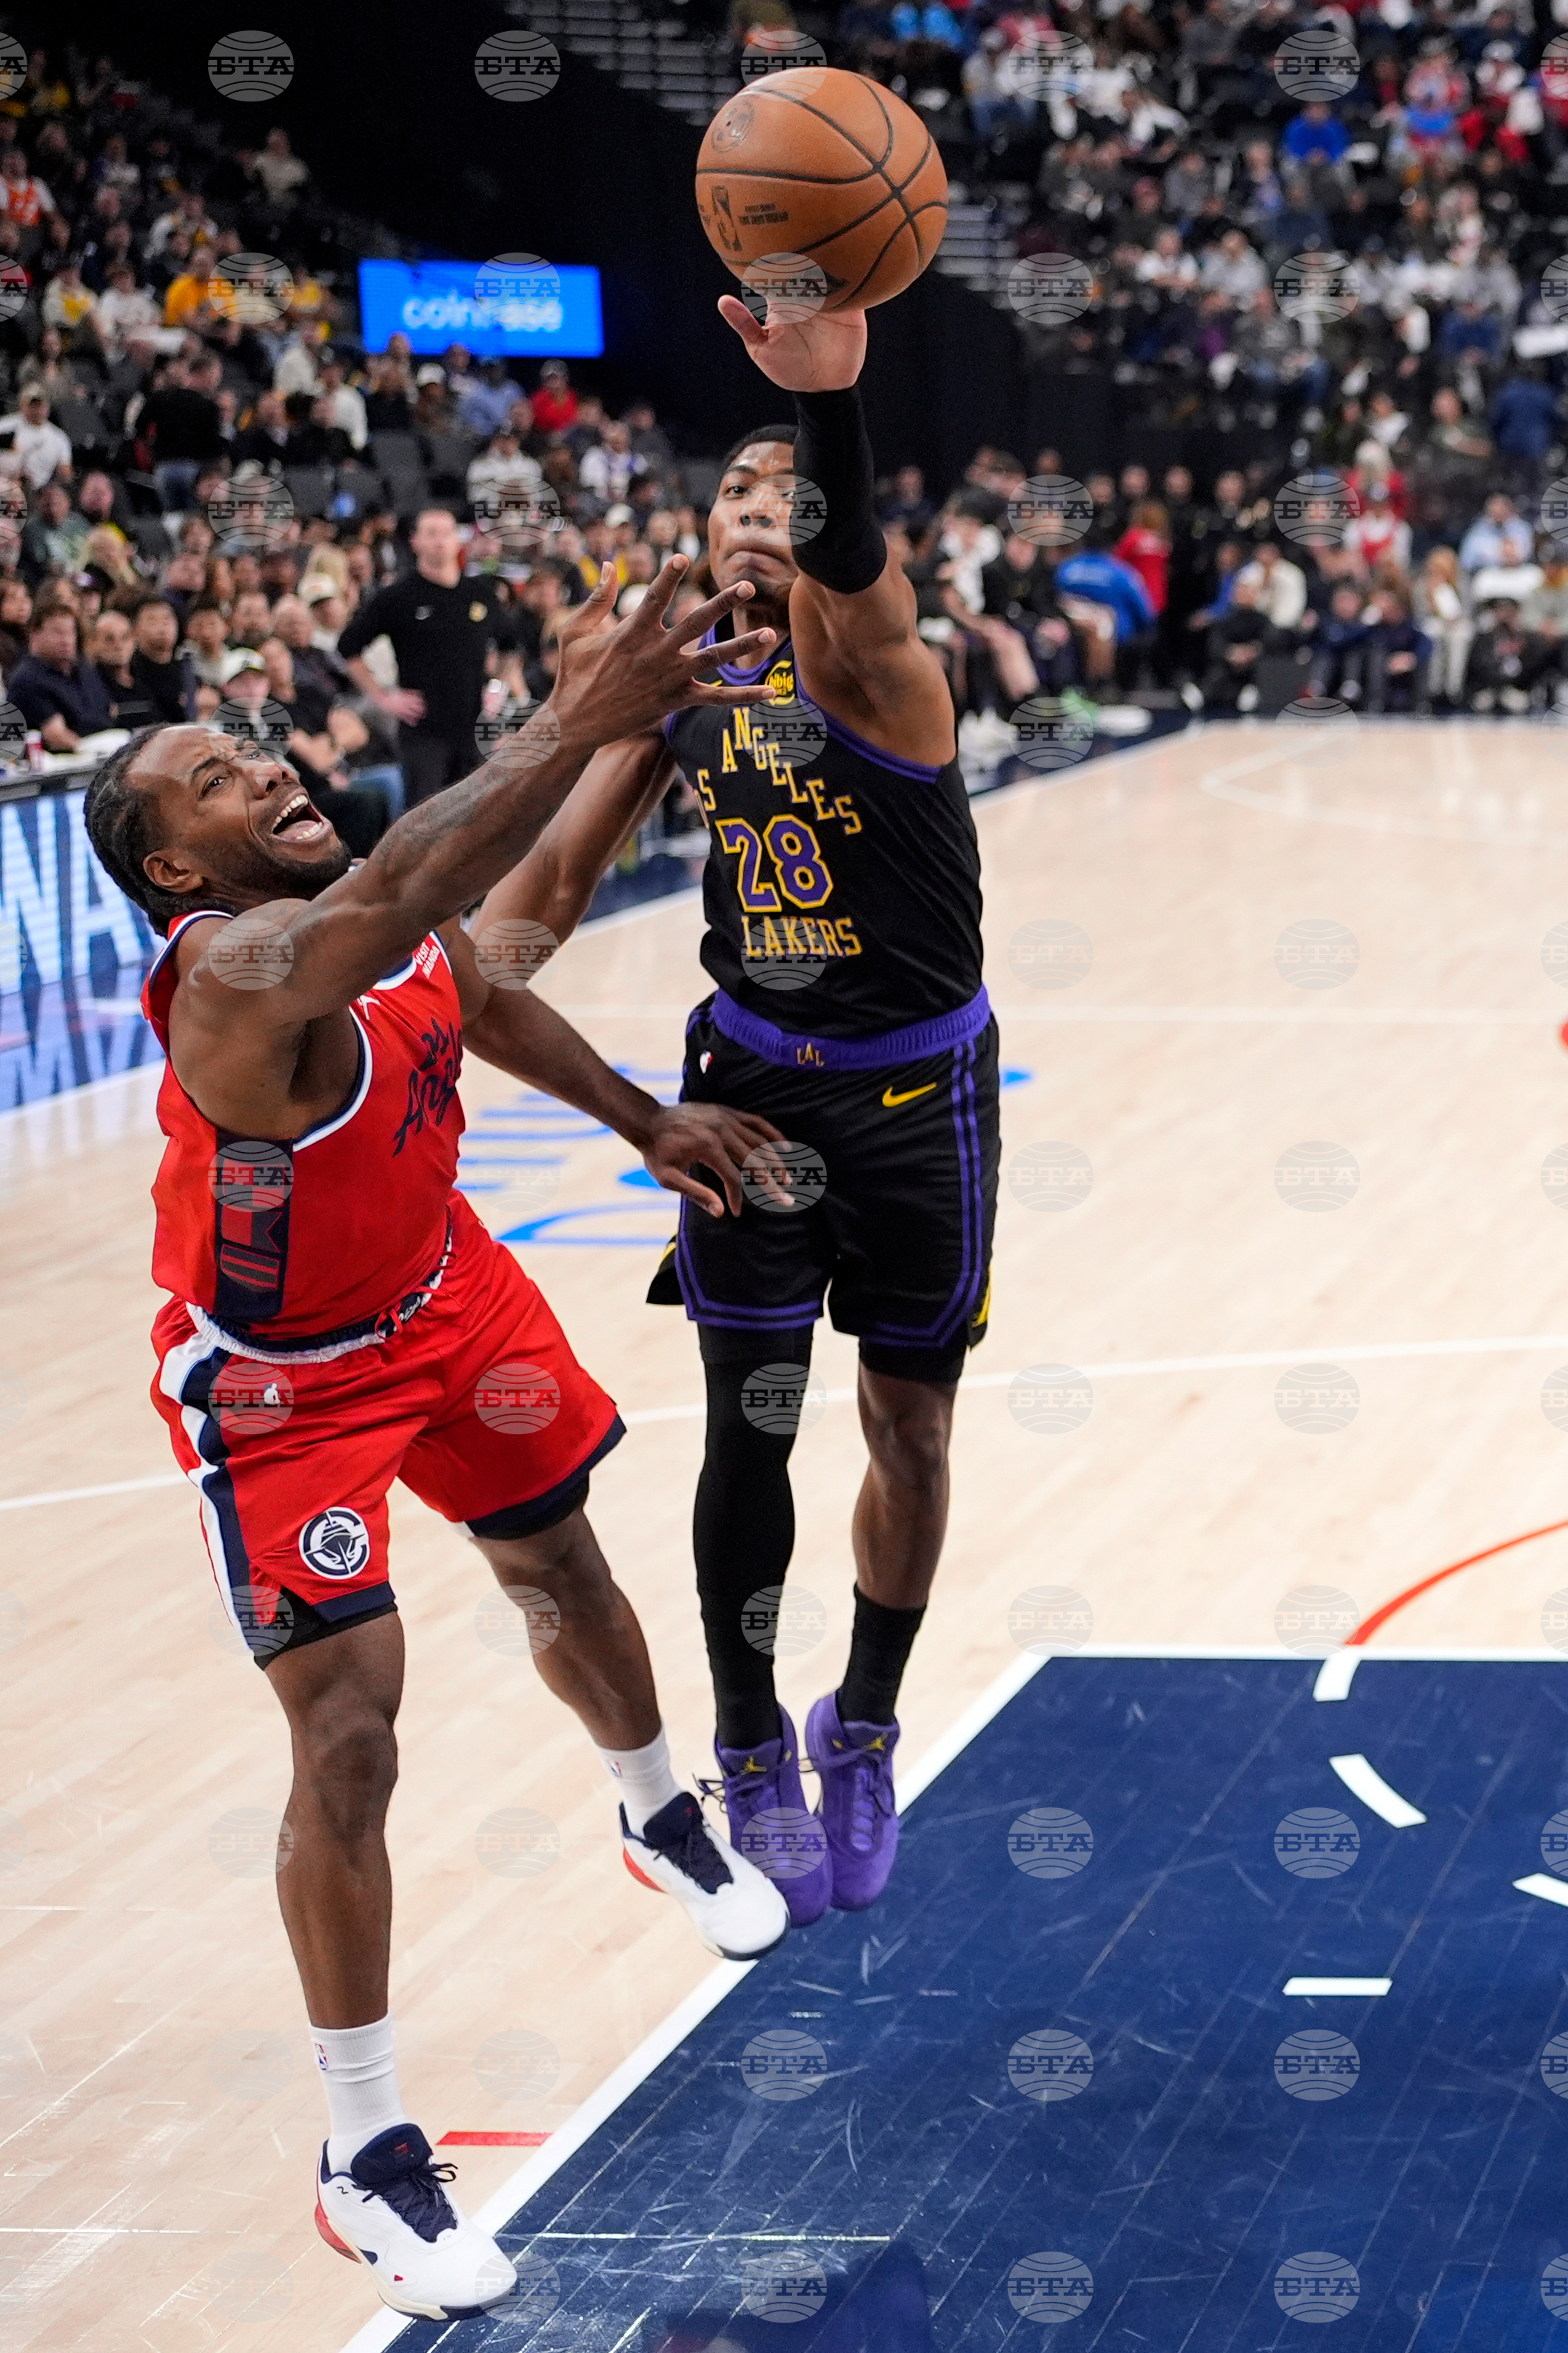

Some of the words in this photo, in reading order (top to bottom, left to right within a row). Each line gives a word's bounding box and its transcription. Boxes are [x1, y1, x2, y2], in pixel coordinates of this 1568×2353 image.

[721, 706, 863, 836] ANGELES
[714, 813, 834, 913] 28
[414, 941, 430, 966] VISIT
[741, 914, 862, 957] LAKERS
[796, 1042, 825, 1068] LAL
